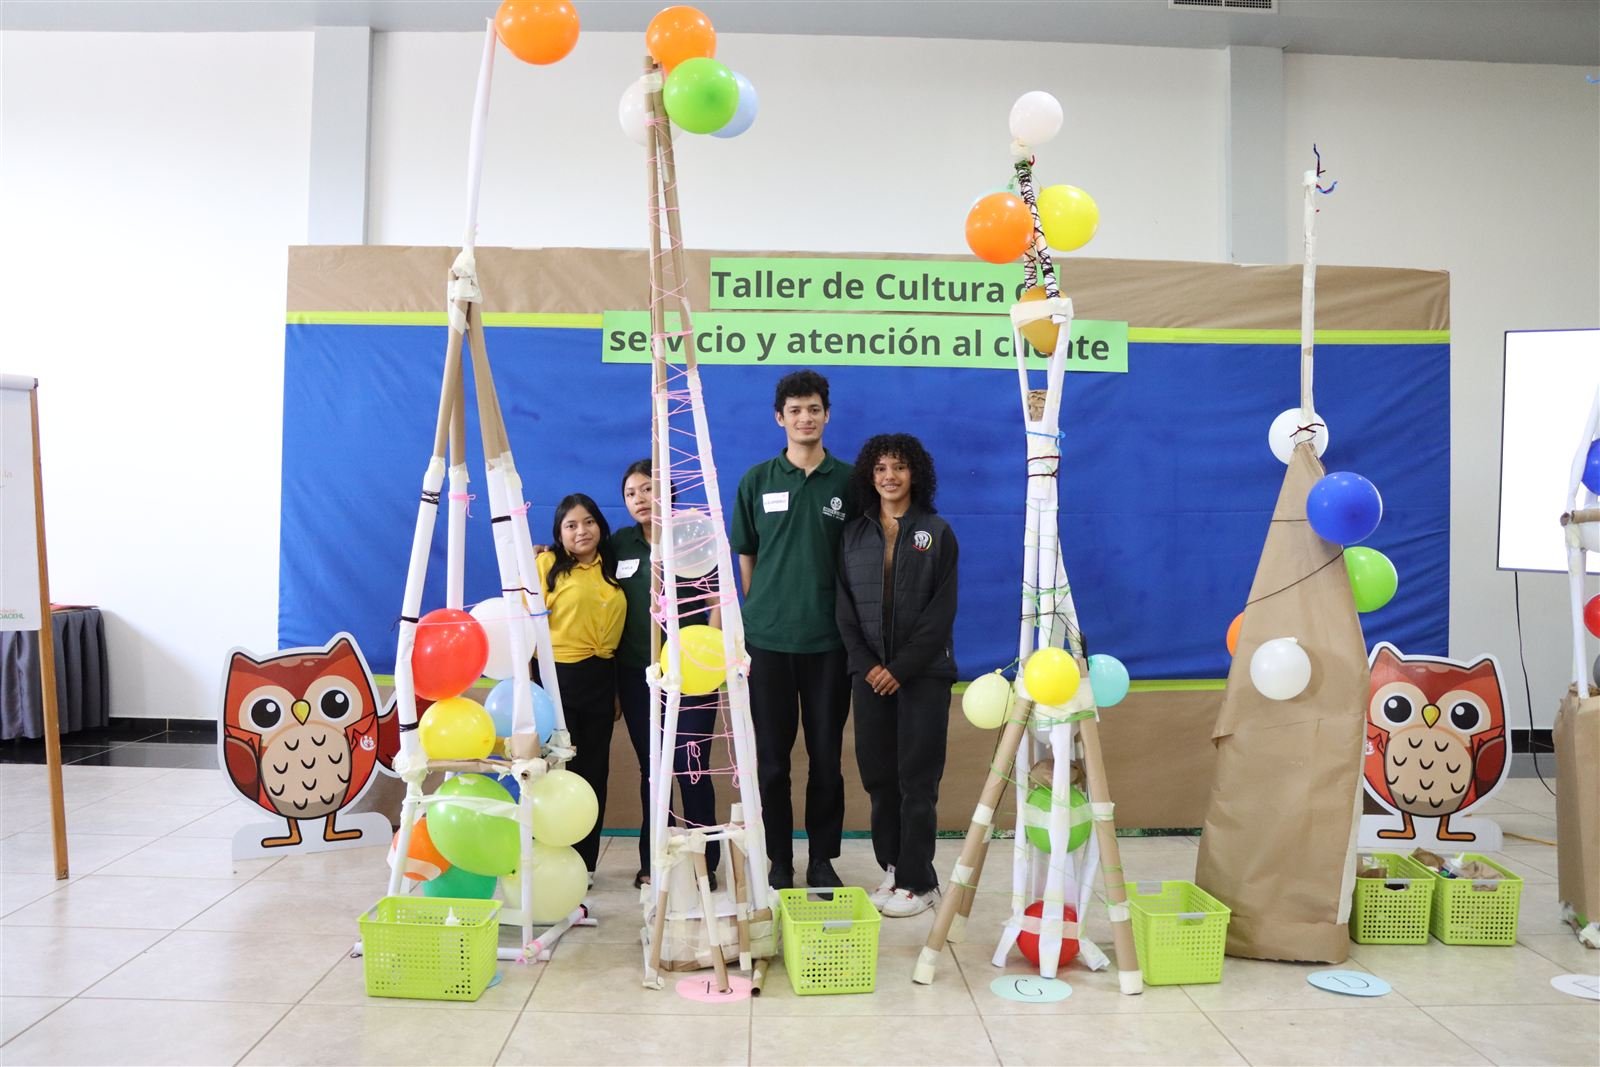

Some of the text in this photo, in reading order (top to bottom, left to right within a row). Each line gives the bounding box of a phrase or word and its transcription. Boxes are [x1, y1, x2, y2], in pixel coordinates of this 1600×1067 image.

[711, 270, 812, 299] Taller
[823, 271, 864, 300] de
[875, 273, 1004, 303] Cultura
[610, 325, 746, 353] sevcio
[757, 332, 776, 361] y
[787, 327, 940, 356] atención
[952, 329, 982, 357] al
